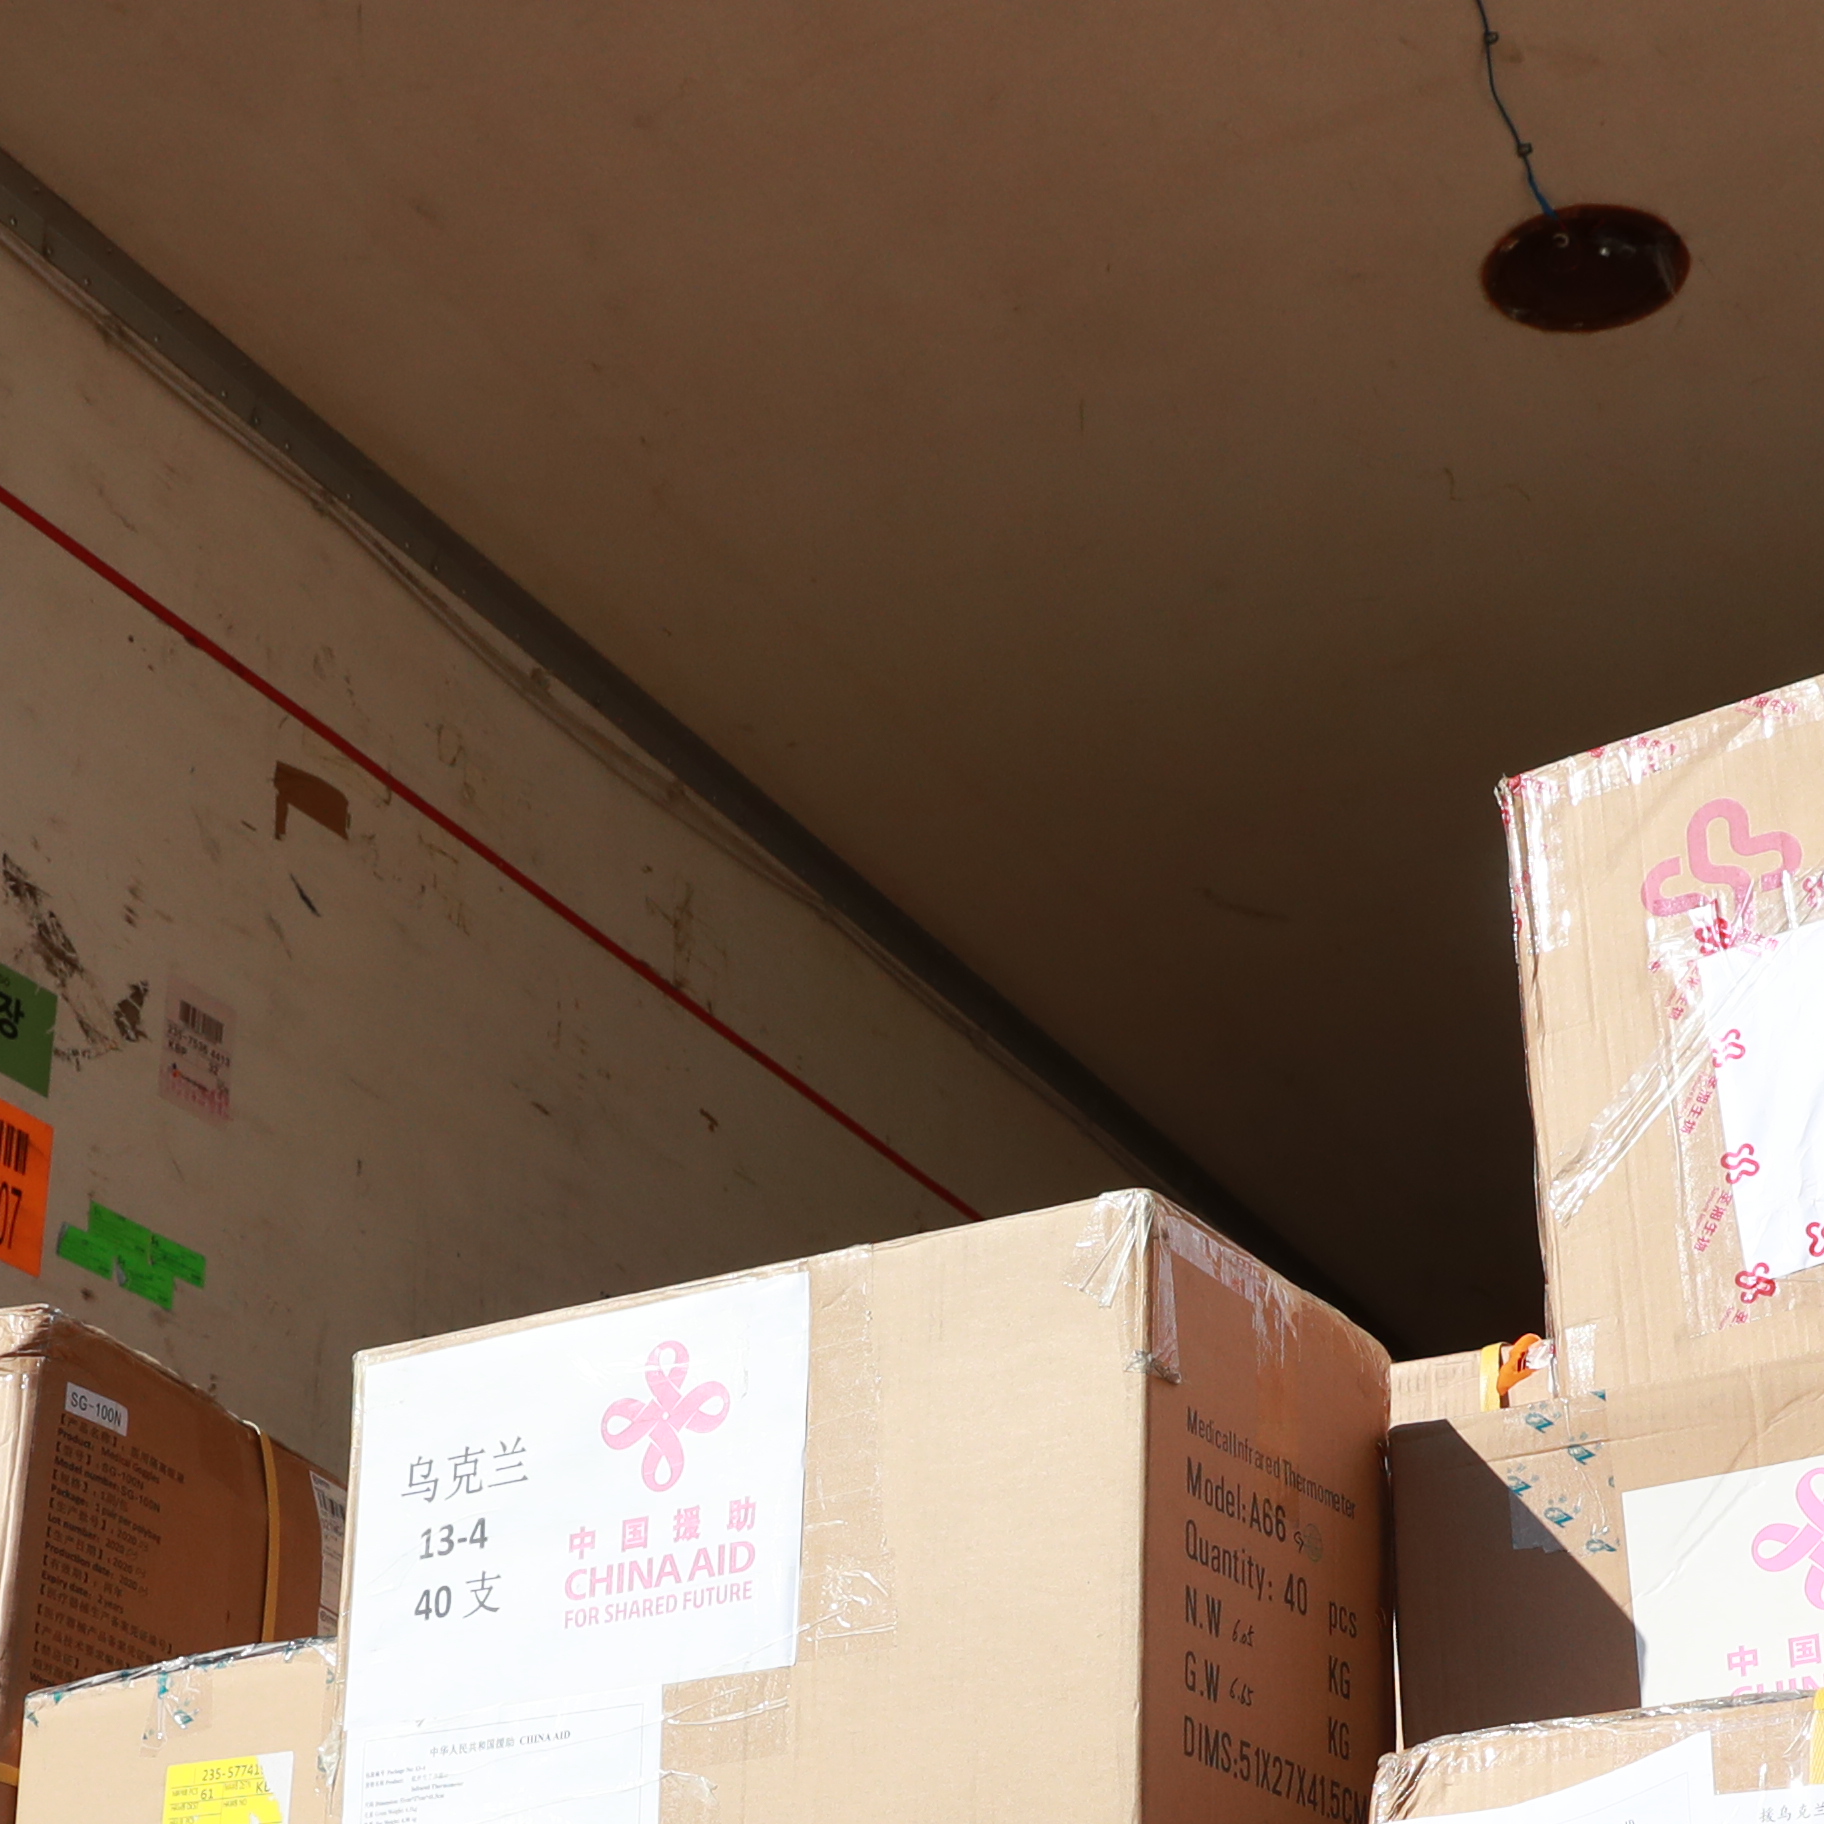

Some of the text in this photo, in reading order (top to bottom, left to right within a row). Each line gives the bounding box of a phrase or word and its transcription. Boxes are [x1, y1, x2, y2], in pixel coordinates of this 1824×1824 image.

[69, 1391, 122, 1427] SG-100N
[401, 1435, 529, 1502] 乌克兰
[1282, 1458, 1357, 1521] Thermometer
[419, 1517, 488, 1560] 13-4
[569, 1496, 757, 1560] 中国援助
[414, 1570, 501, 1620] 40 支
[565, 1540, 756, 1601] CHINA AID
[1185, 1519, 1358, 1639] Quantity: 40 pcs
[564, 1580, 753, 1629] FOR SHARED FUTURE
[1185, 1584, 1352, 1701] N.W KG
[1185, 1650, 1350, 1761] G.W KG
[200, 1788, 214, 1800] 61
